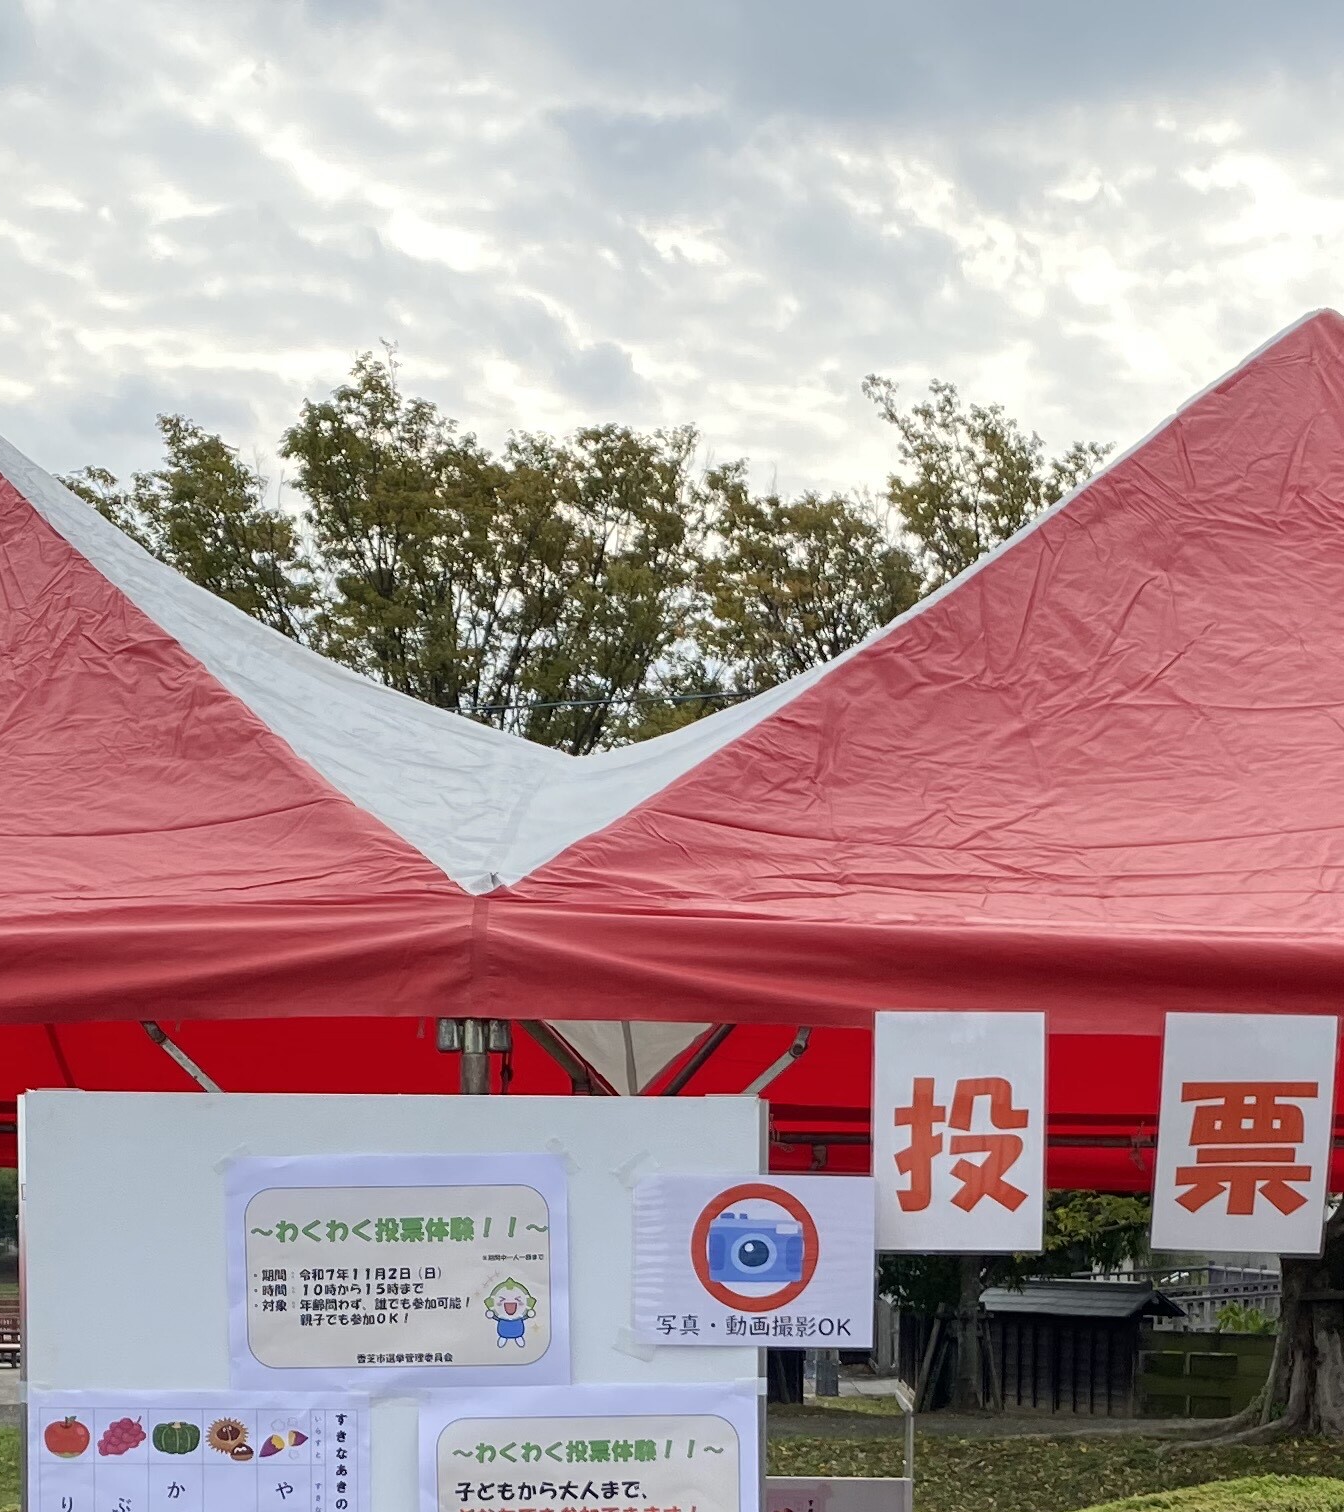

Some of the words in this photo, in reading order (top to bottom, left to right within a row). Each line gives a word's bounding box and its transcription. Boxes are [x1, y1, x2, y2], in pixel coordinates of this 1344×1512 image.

[656, 1314, 852, 1337] 写真・動画撮影OK
[356, 1353, 453, 1364] 香芝市選挙管理委員会
